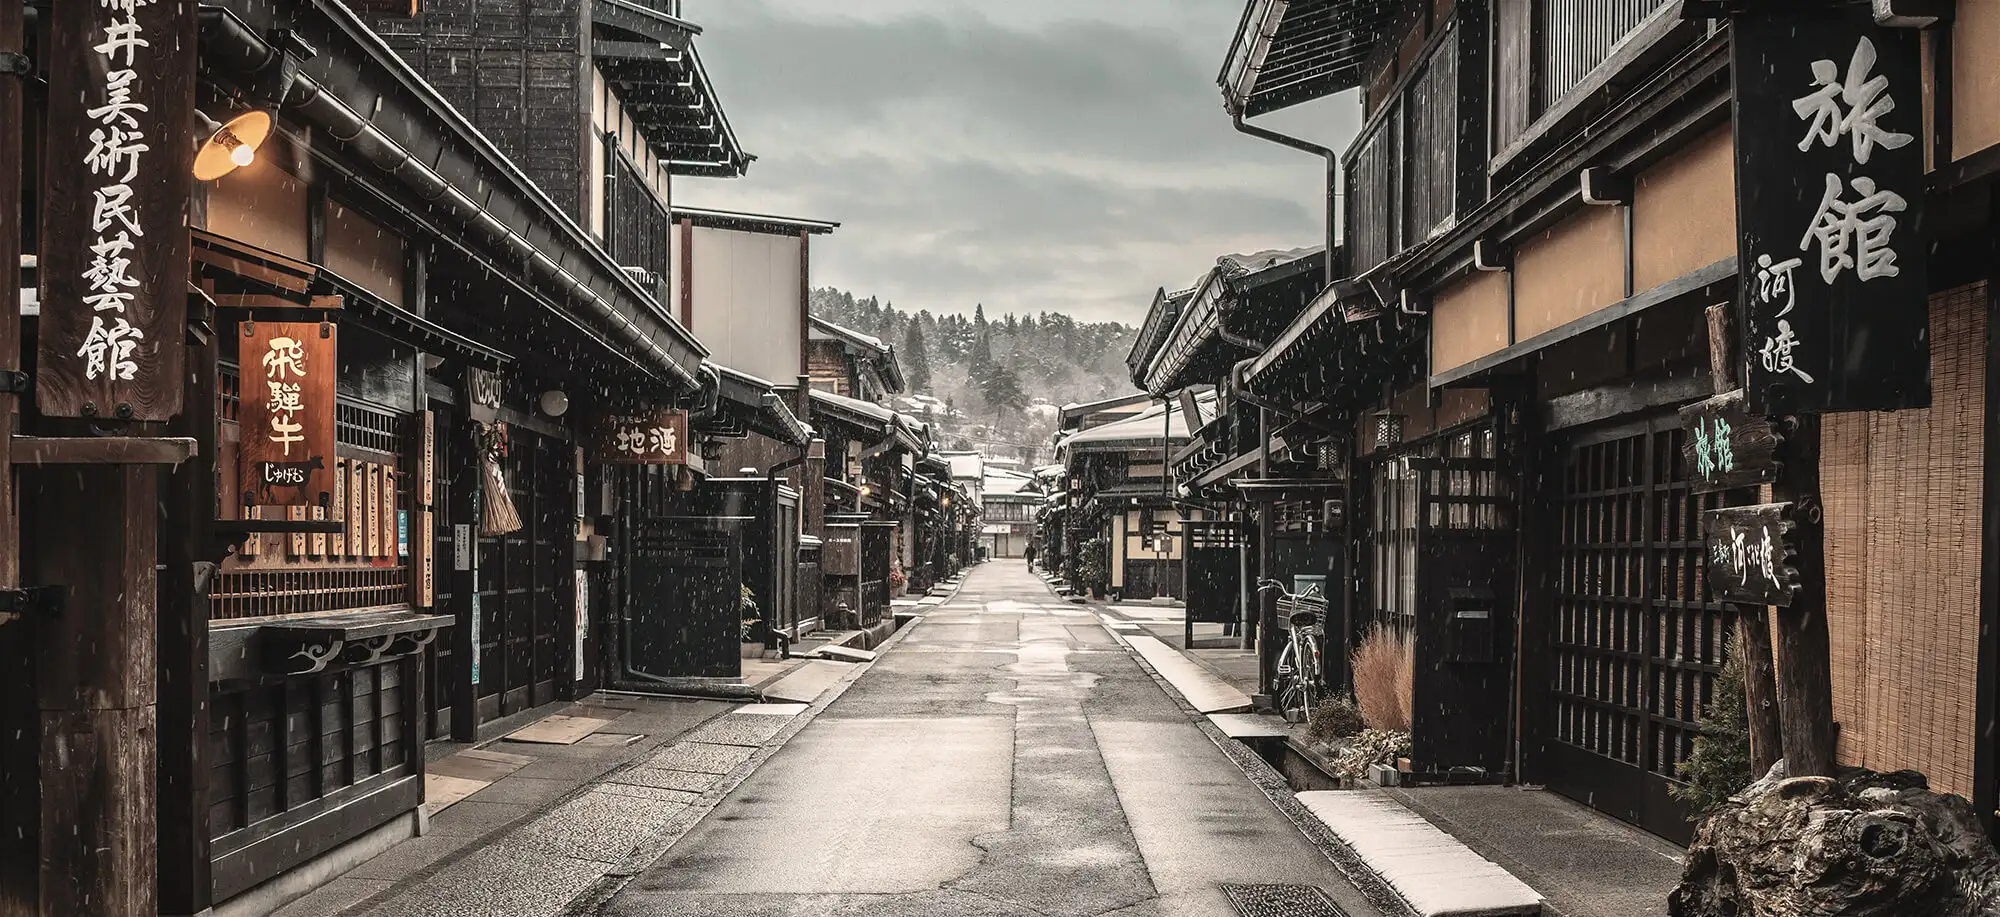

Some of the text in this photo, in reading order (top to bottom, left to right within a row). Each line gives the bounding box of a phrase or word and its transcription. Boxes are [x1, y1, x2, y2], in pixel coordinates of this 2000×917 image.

[77, 0, 157, 381] 井美術民藝館
[1792, 35, 1914, 284] 旅館
[265, 462, 304, 484] じゅげむ
[617, 426, 676, 455] 地酒
[1694, 416, 1733, 482] 旅館
